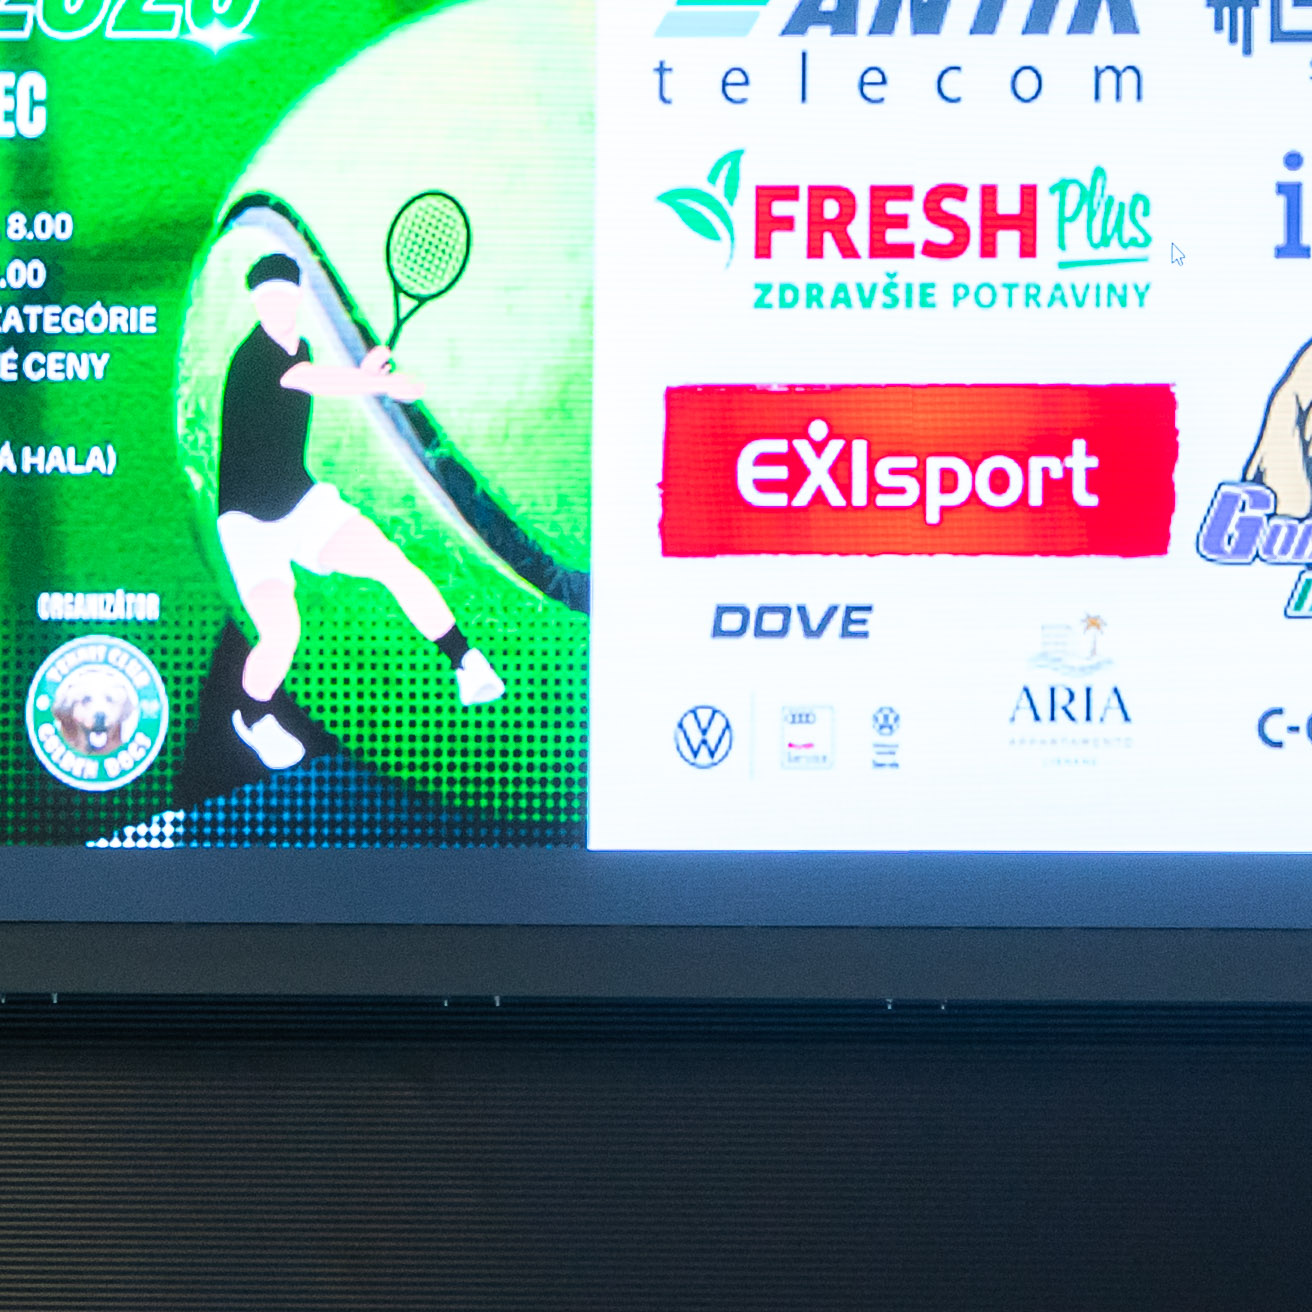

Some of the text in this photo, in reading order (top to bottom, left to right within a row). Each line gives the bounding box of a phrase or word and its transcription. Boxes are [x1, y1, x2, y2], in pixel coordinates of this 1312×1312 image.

[652, 50, 1144, 106] telecom
[6, 211, 74, 241] 8.00
[752, 165, 1153, 261] FRESH Plus
[752, 271, 1152, 310] ZDRAVŠIE POTRAVINY
[23, 351, 110, 380] CENY
[21, 444, 117, 476] HALA)
[711, 603, 876, 640] DOVE
[1009, 684, 1132, 724] ARIA
